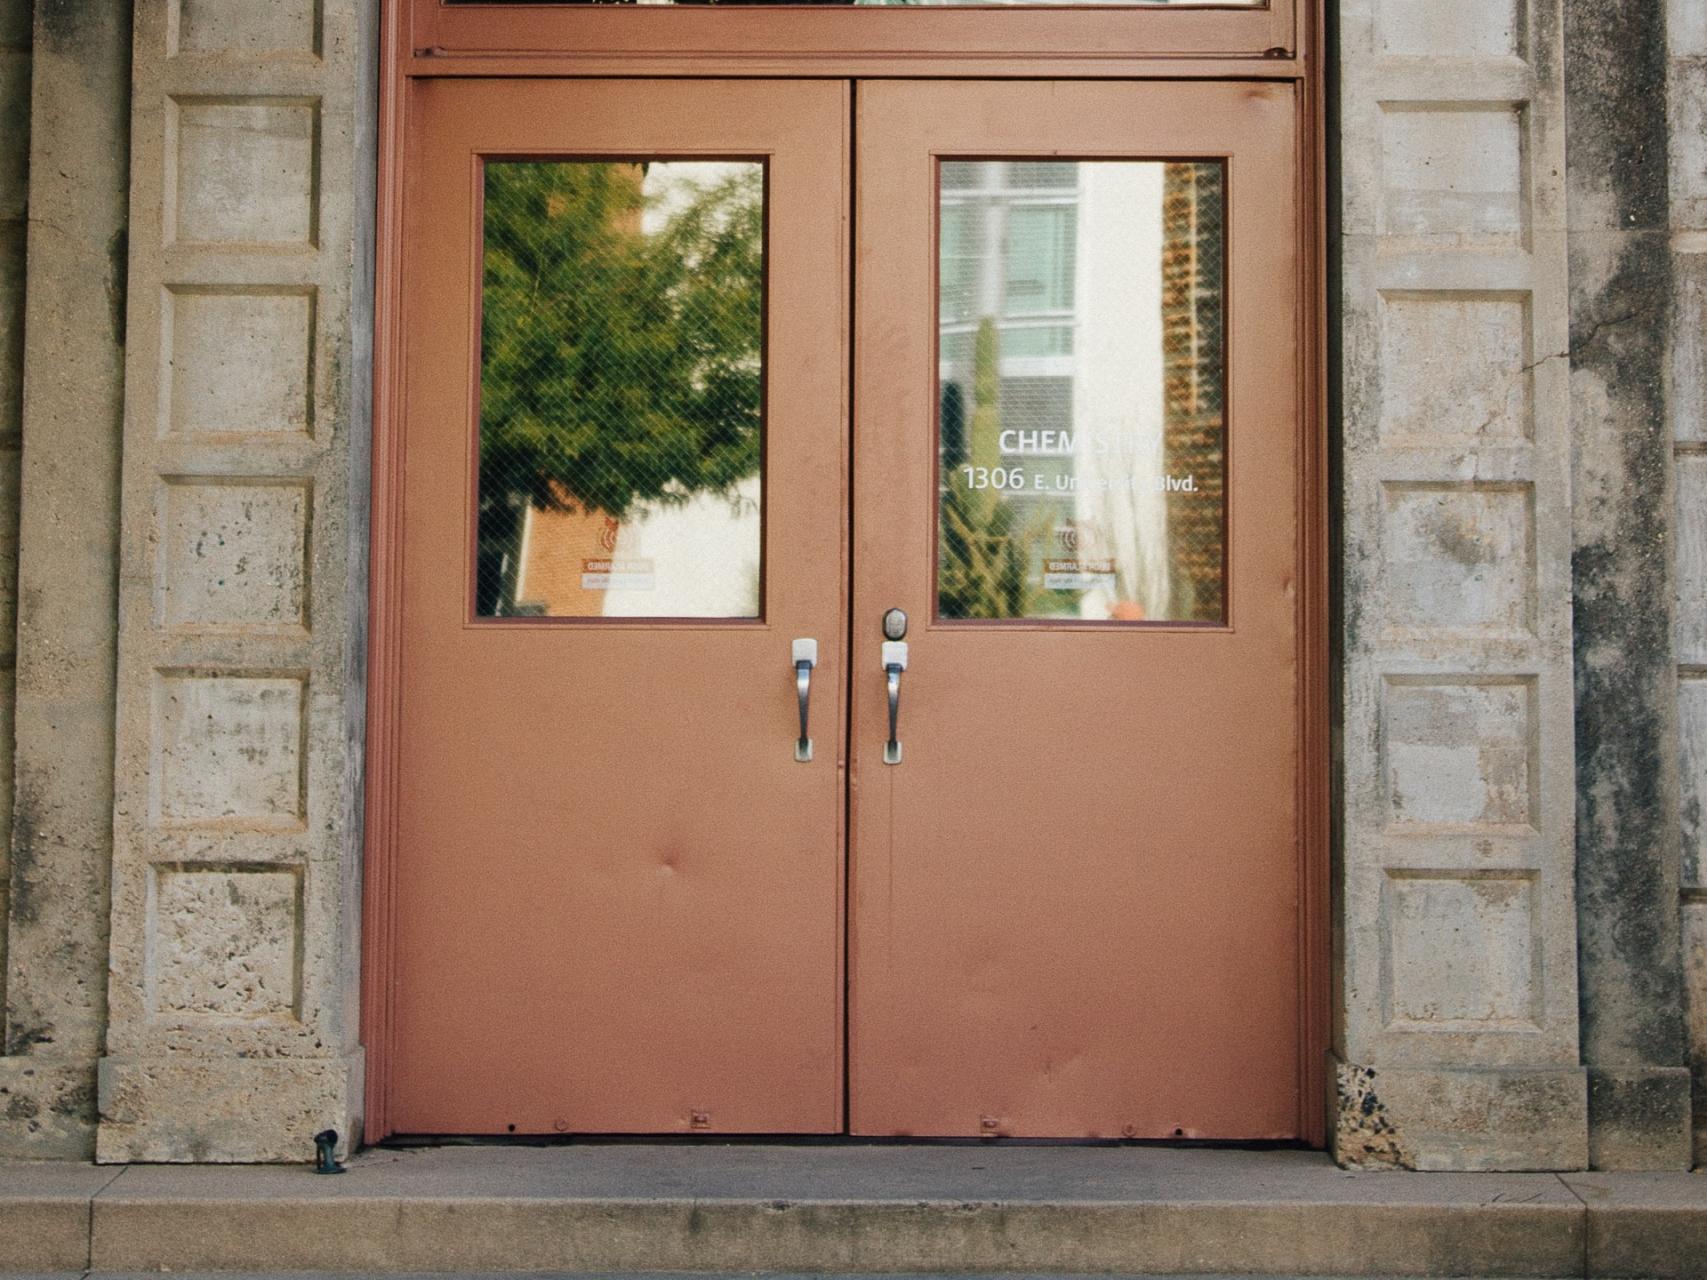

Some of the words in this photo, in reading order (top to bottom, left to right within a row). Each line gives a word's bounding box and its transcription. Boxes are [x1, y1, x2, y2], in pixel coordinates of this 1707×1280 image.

[963, 467, 1025, 489] 1306
[1034, 474, 1050, 490] E.
[1154, 474, 1199, 492] Blvd.
